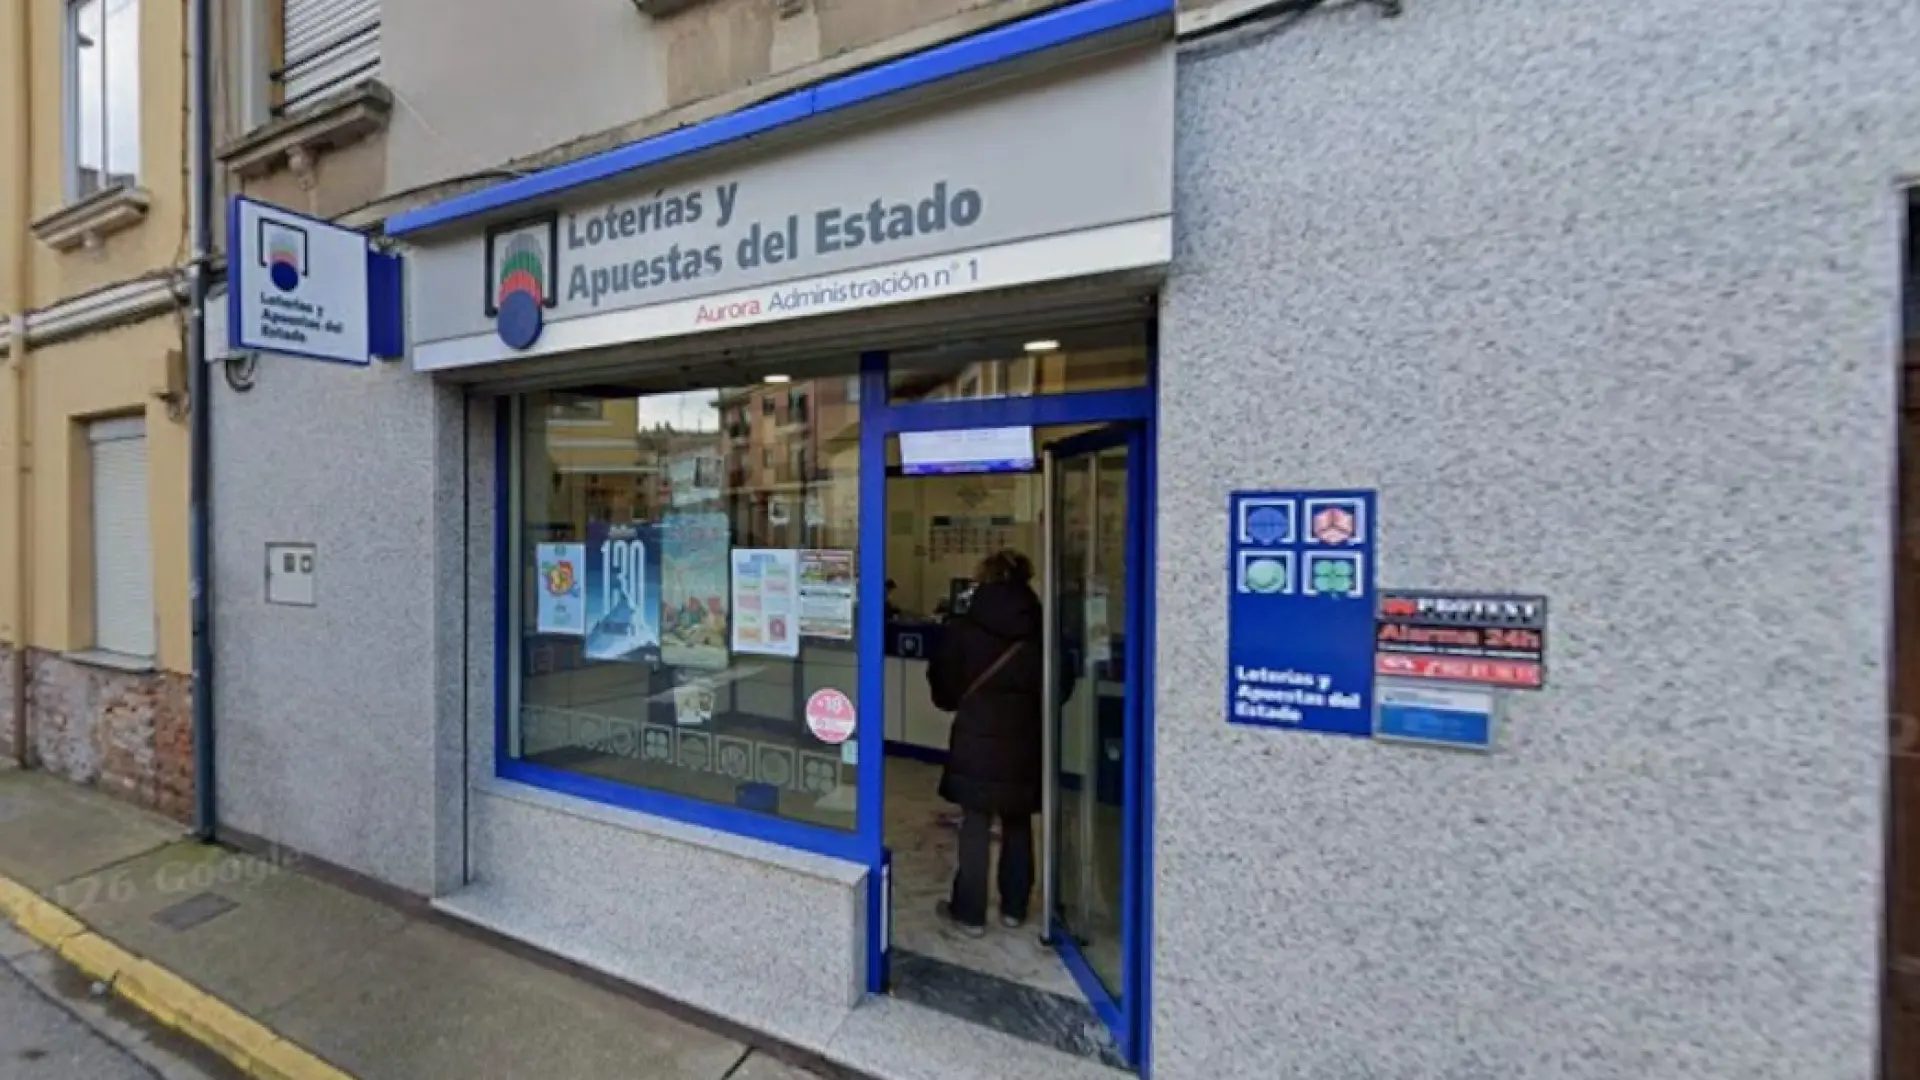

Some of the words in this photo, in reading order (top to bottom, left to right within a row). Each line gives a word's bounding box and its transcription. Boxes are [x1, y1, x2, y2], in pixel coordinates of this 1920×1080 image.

[568, 187, 702, 250] Loterías
[716, 182, 738, 227] y
[567, 243, 722, 306] Apuestas
[737, 214, 798, 270] del
[815, 180, 982, 255] Estado
[695, 300, 760, 324] Aurora
[768, 270, 929, 312] Administración
[968, 258, 979, 281] 1
[601, 539, 646, 630] 130
[1378, 624, 1480, 646] Alarma
[1484, 628, 1541, 649] 24h
[1236, 684, 1324, 707] Apuestas
[1327, 691, 1361, 710] del
[1318, 673, 1332, 691] y
[1234, 700, 1303, 721] Estado
